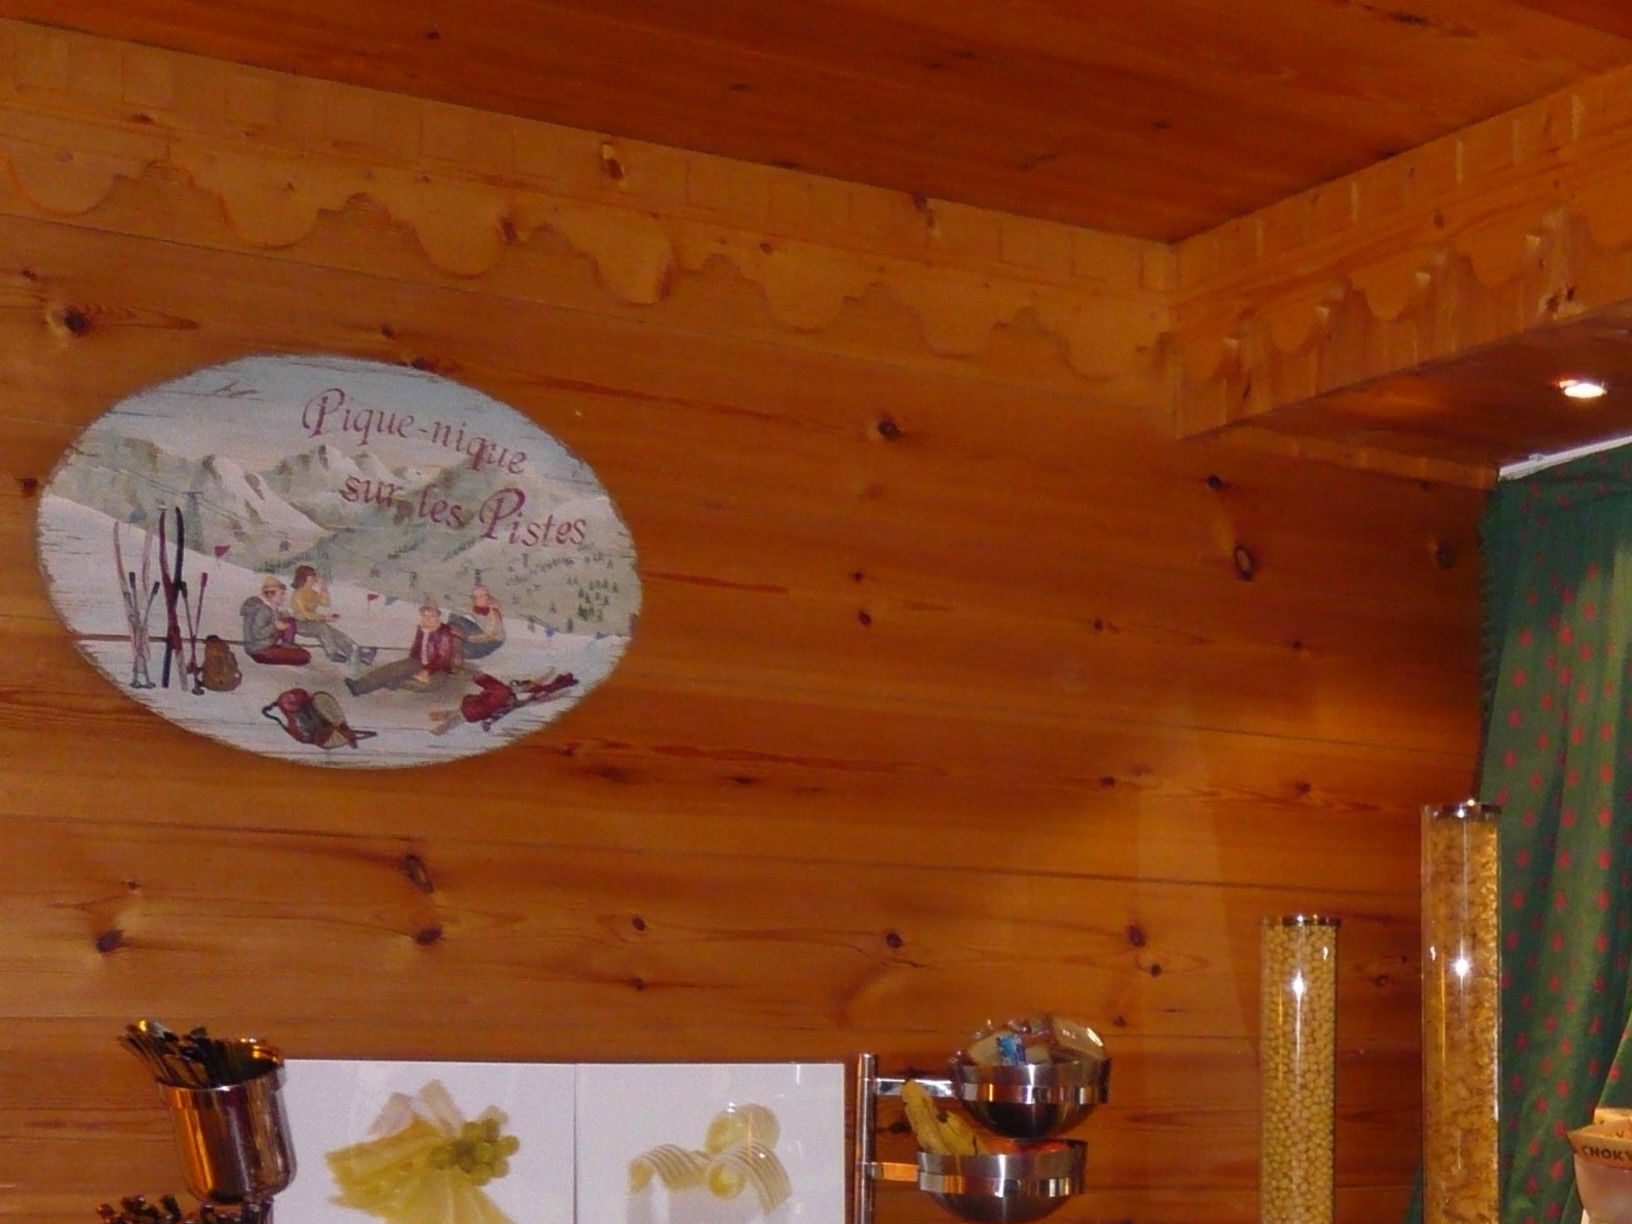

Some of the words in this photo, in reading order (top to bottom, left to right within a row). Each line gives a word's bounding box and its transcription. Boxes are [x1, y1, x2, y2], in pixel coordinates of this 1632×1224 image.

[302, 387, 528, 474] Pique-nique
[340, 475, 400, 507] sur
[417, 484, 464, 528] les
[479, 487, 588, 547] Pistes
